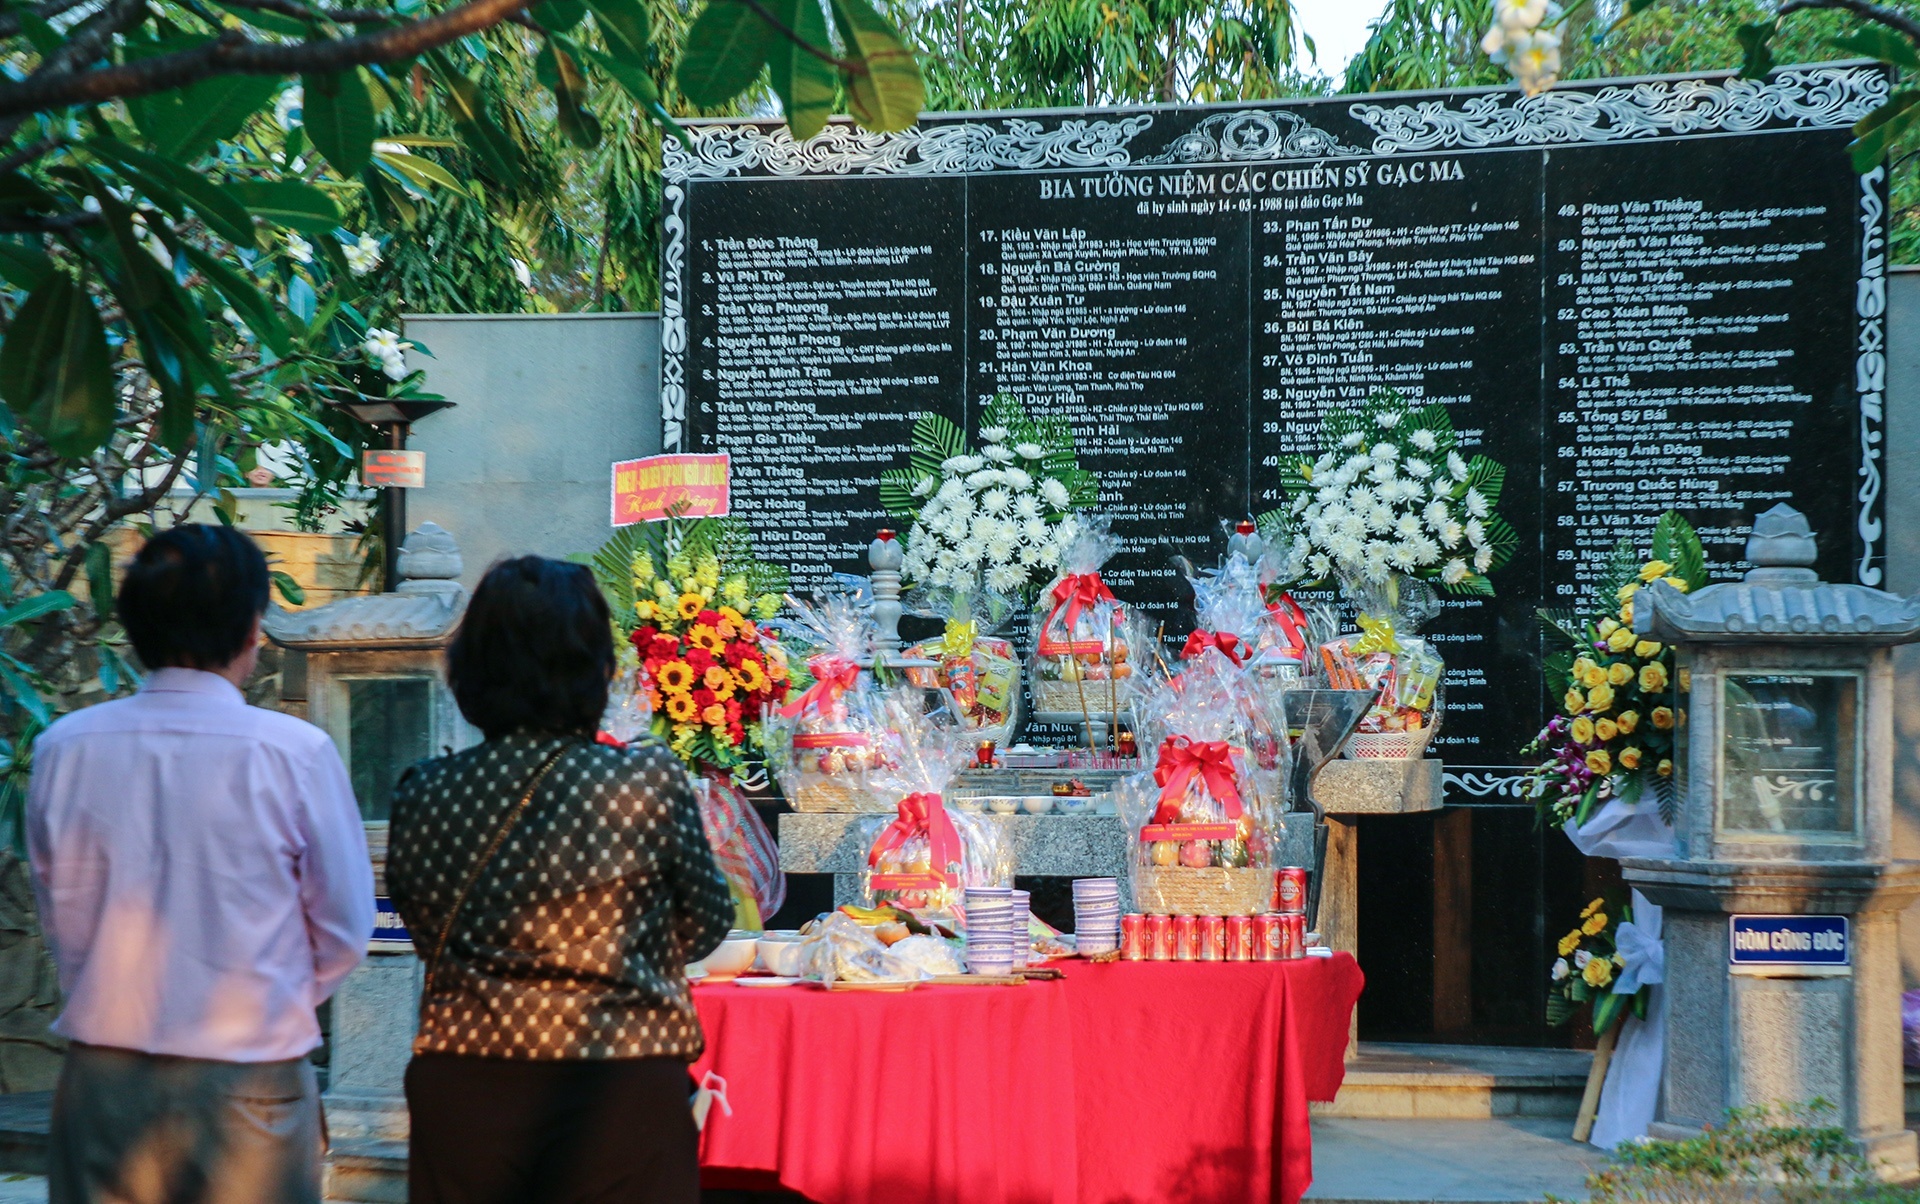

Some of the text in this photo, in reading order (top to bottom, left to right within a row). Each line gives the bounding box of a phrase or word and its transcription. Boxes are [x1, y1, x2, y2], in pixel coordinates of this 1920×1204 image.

[1040, 160, 1465, 199] BIA TƯỞNG NIỆM CÁC CHIẾN SỸ GẠC MA
[1137, 193, 1363, 216] đã hy sinh ngày 14 03 1988 tại đảo Gạc Ma
[1264, 217, 1372, 233] 33. Phan Tấn Dư
[980, 228, 1086, 241] 17. Kiều Văn Lập
[701, 240, 713, 251] 1.
[778, 237, 818, 251] Thông
[1264, 256, 1282, 267] 34.
[1286, 253, 1315, 265] Trần
[1319, 253, 1344, 263] Văn
[980, 264, 997, 274] 18.
[1002, 261, 1050, 276] Nguyễn
[1075, 261, 1120, 275] Cường
[702, 273, 714, 283] 2.
[1264, 284, 1395, 302] 35. Nguyễn Tất Nam
[979, 297, 997, 307] 19.
[1000, 296, 1026, 308] Đậu
[1030, 295, 1062, 306] Xuân
[702, 305, 714, 316] 3.
[749, 304, 773, 314] Văn
[1264, 319, 1363, 333] 36. Bùi Bá Kiên
[702, 337, 714, 348] 4.
[800, 334, 841, 347] Phong
[979, 328, 1116, 342] 20. Phạm Văn Dương
[1263, 356, 1281, 366] 37.
[1285, 355, 1303, 365] Võ
[1341, 351, 1373, 363] Tuấn
[979, 362, 997, 372] 21.
[1031, 361, 1054, 371] Văn
[1059, 360, 1092, 371] Khoa
[703, 369, 714, 380] 5.
[770, 367, 800, 378] Minh
[1027, 394, 1051, 406] Duy
[1263, 389, 1282, 400] 38.
[1286, 387, 1335, 402] Nguyễn
[1339, 386, 1365, 397] Văn
[701, 402, 713, 413] 6.
[749, 401, 771, 412] Văn
[1559, 413, 1578, 423] 55.
[701, 434, 713, 445] 7.
[716, 434, 752, 447] Phạm
[756, 434, 777, 444] Gia
[1171, 436, 1182, 444] 146
[1558, 447, 1578, 457] 56.
[1582, 445, 1627, 458] Hoàng
[1558, 481, 1577, 491] 57.
[1558, 514, 1666, 526] 58. Lê Văn Xan
[1735, 928, 1769, 950] HÒM
[1771, 928, 1811, 950] CÔNG
